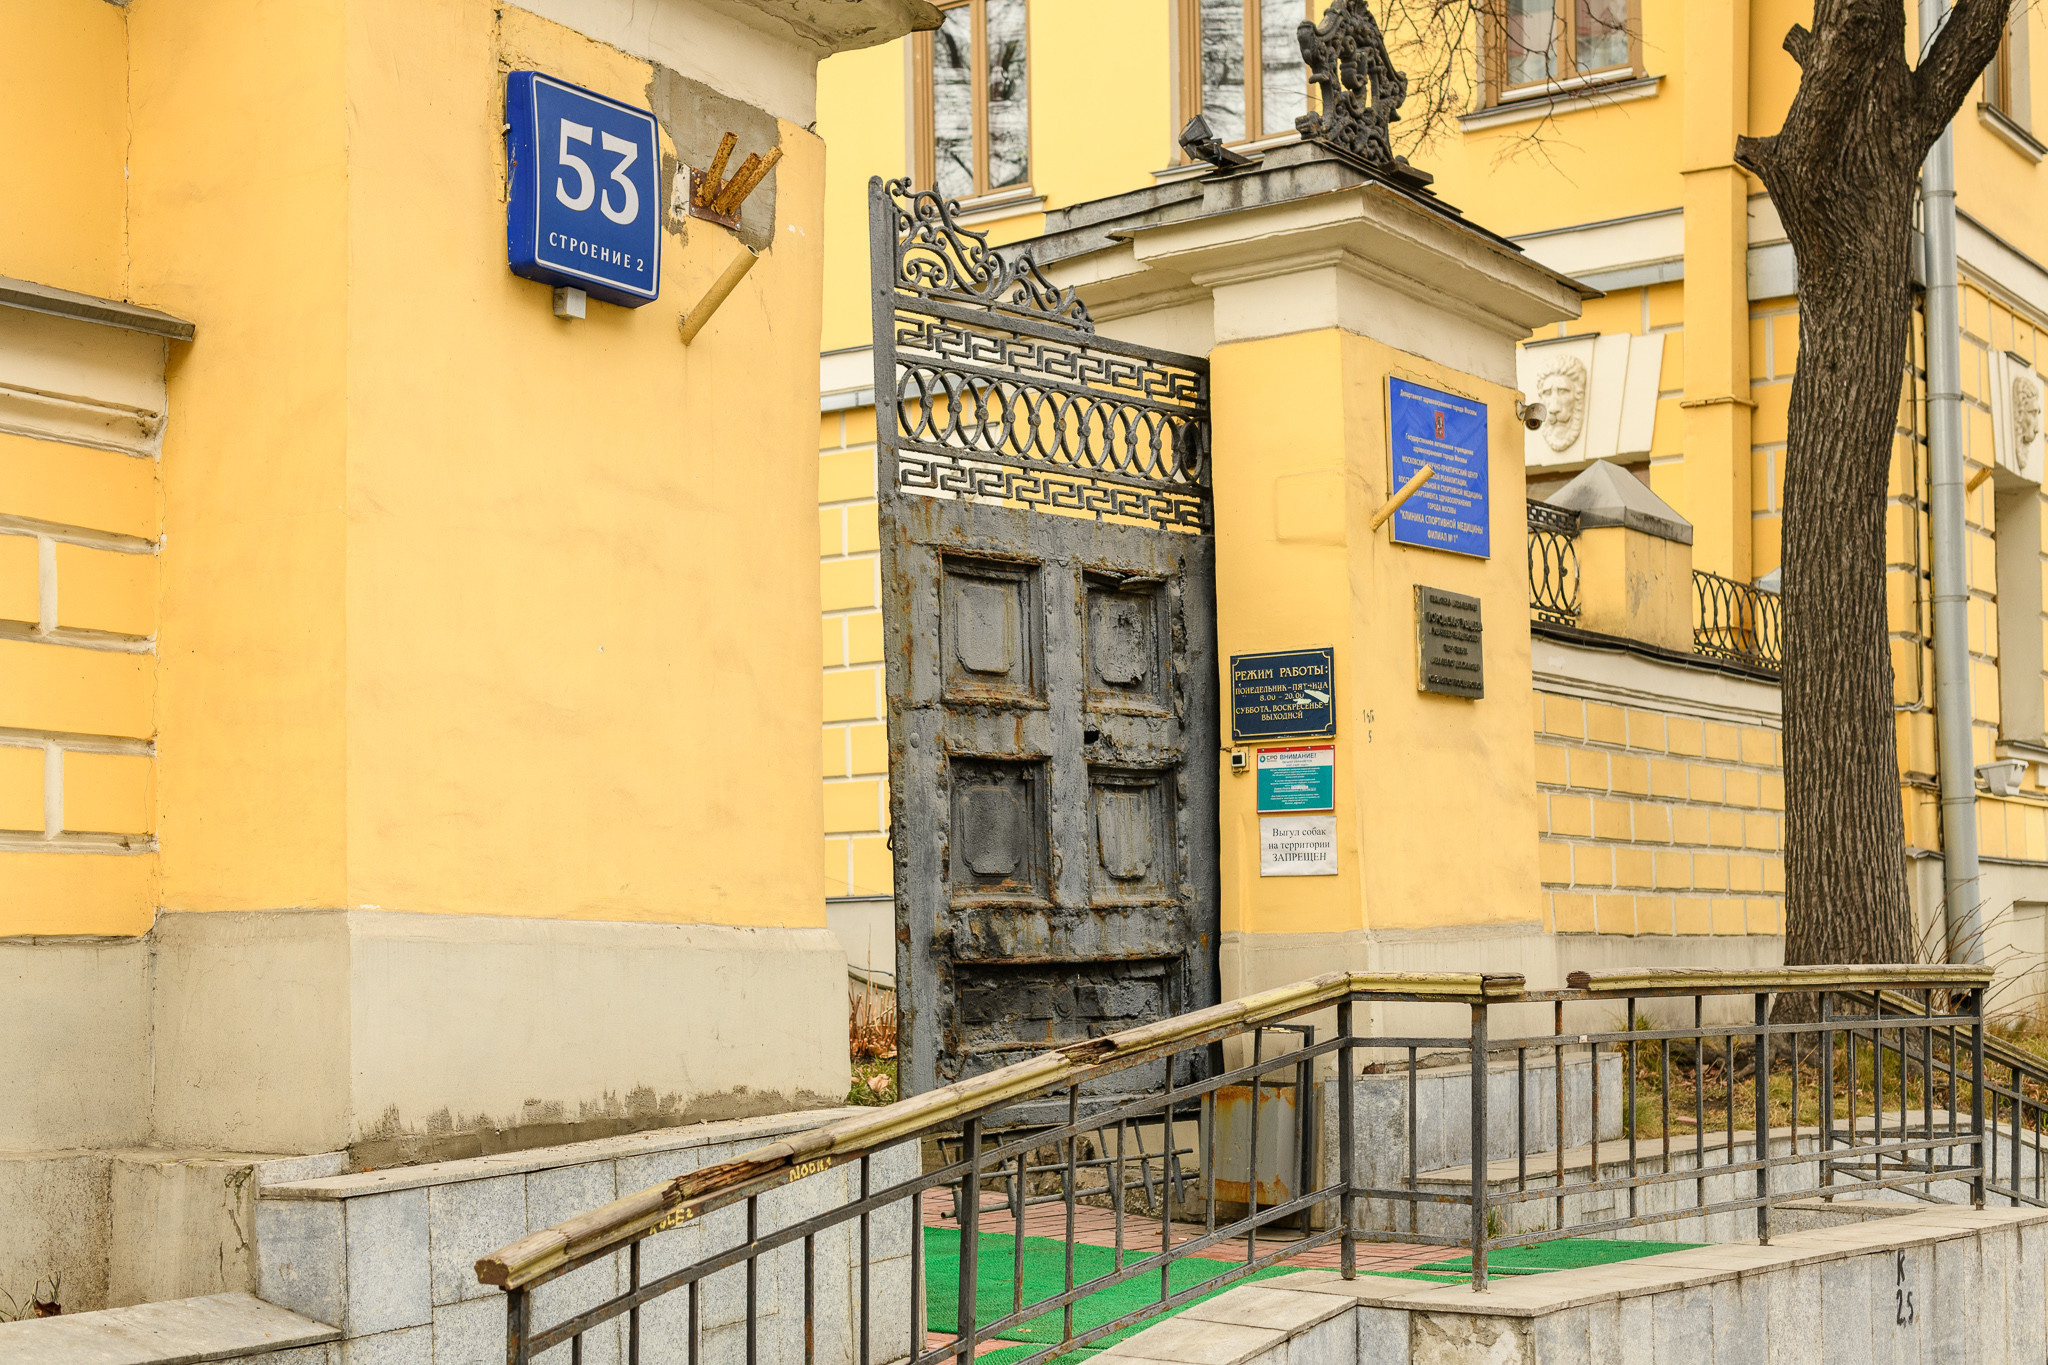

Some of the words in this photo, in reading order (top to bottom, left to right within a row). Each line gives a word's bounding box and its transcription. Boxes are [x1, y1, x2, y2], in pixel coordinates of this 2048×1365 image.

[556, 118, 639, 225] 53
[549, 231, 631, 269] СТРОЕНИЕ
[636, 258, 644, 272] 2
[1400, 509, 1425, 523] "КЛИНИКА
[1425, 515, 1456, 529] СПОРТИВНОЙ
[1457, 521, 1483, 534] МЕДИЦИНЫ
[1427, 529, 1447, 542] ФИЛИАЛ
[1235, 668, 1274, 681] РЕЖИМ
[1280, 665, 1328, 677] РАБОТЫ:
[1272, 702, 1324, 713] ВОСКРЕСЕНЬЕ
[1261, 710, 1303, 721] ВЫХОДНОЙ
[1279, 752, 1317, 760] ВНИМАНИЕ!
[1272, 828, 1300, 839] Выгул
[1302, 826, 1327, 836] собак
[1268, 842, 1278, 850] на
[1280, 840, 1330, 851] территории
[1272, 852, 1327, 862] ЗАПРЕЩЕН
